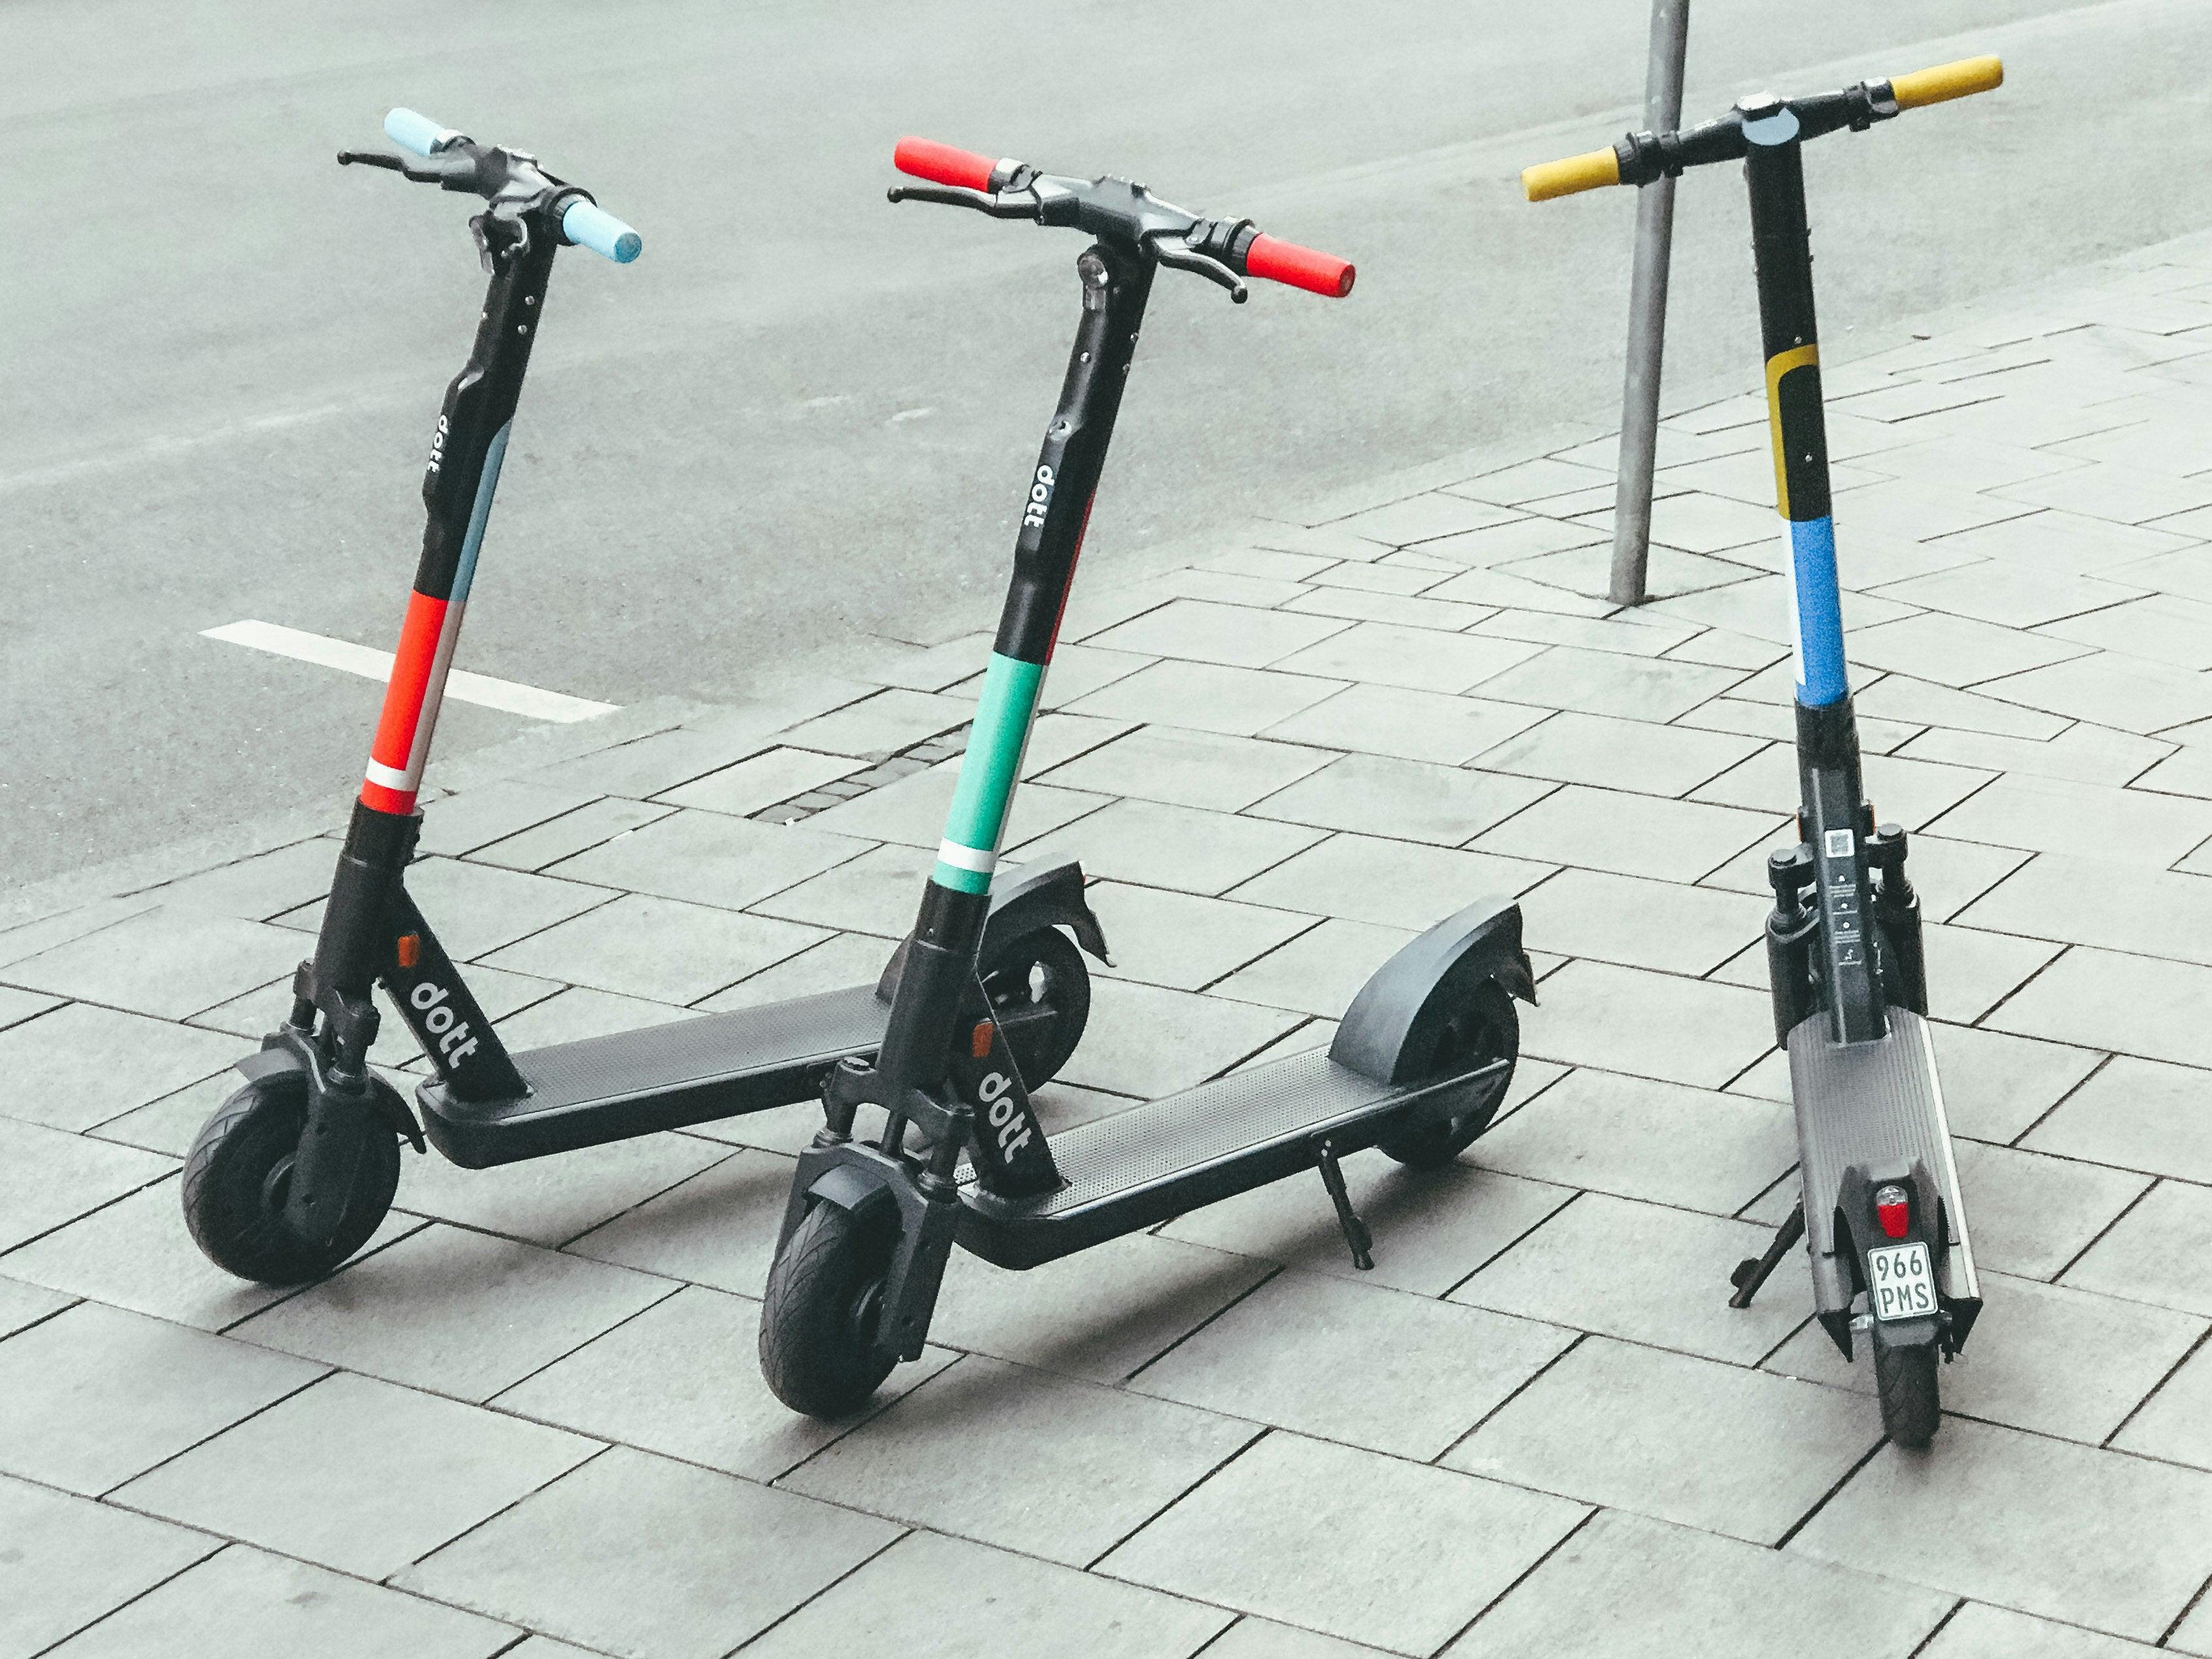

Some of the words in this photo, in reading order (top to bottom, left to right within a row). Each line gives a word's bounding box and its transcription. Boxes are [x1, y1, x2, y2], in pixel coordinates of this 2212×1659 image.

[427, 415, 449, 472] dott
[1024, 464, 1055, 528] dott
[411, 982, 479, 1068] dott
[978, 1072, 1032, 1164] dott
[1876, 1249, 1923, 1282] 966
[1880, 1282, 1929, 1314] PMS
